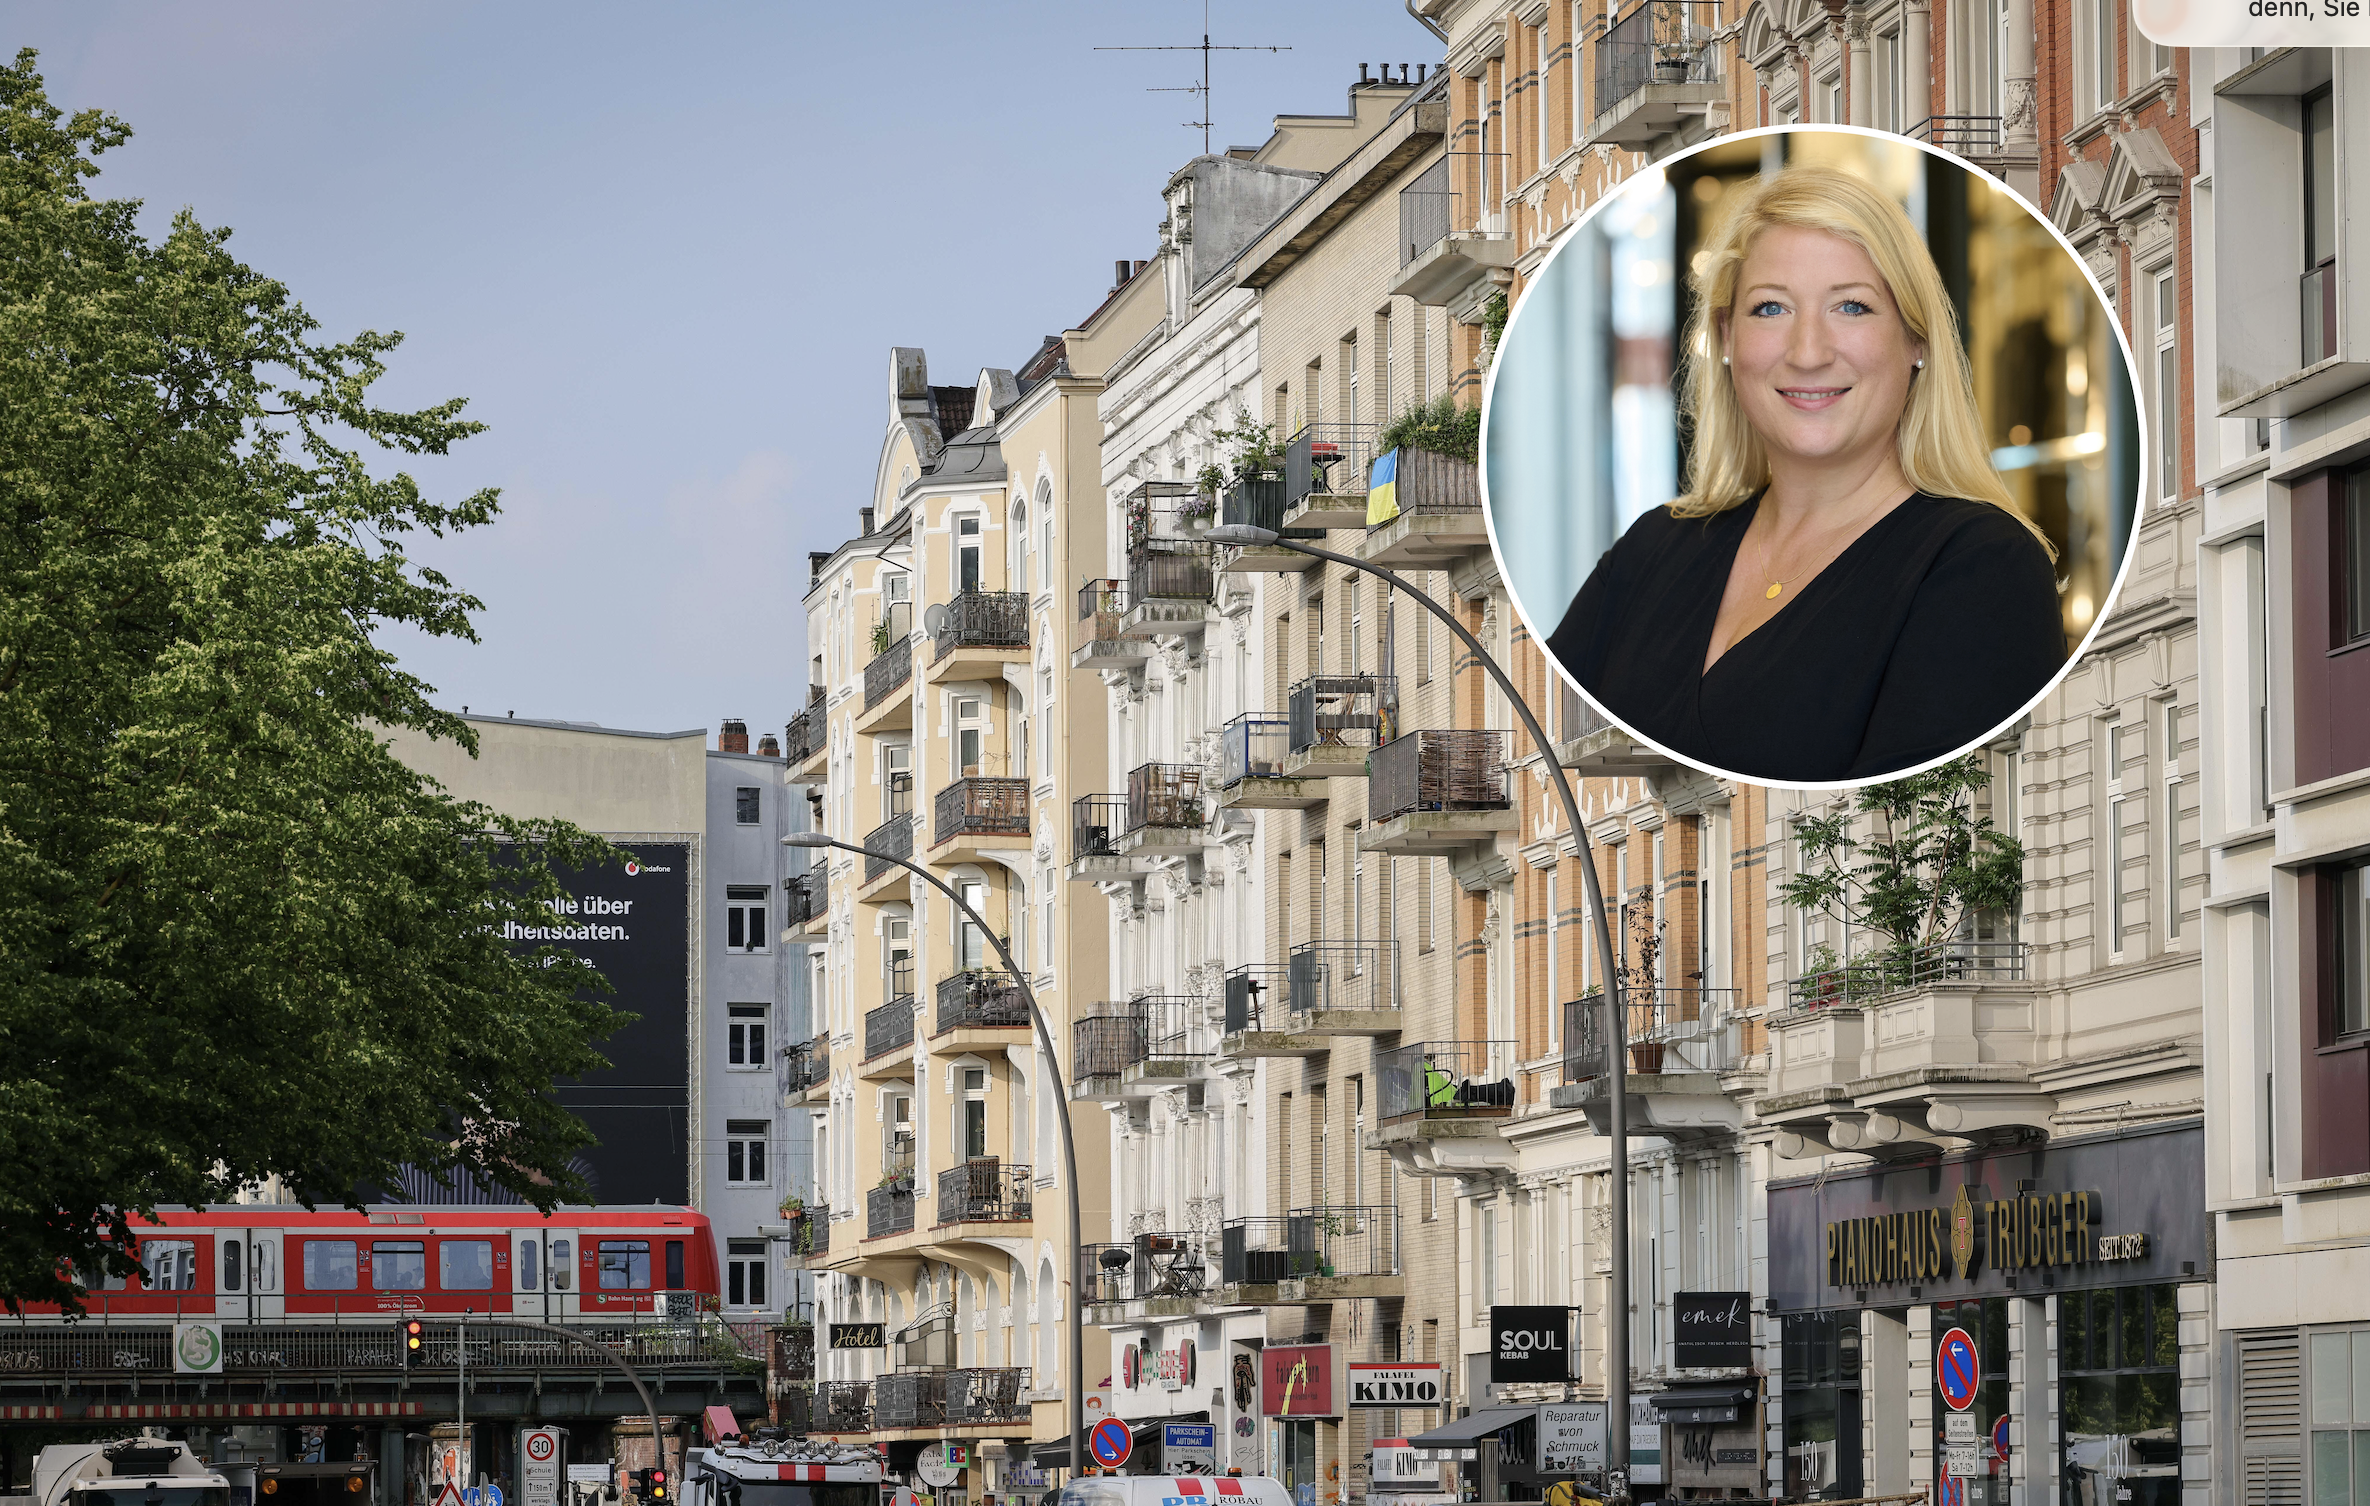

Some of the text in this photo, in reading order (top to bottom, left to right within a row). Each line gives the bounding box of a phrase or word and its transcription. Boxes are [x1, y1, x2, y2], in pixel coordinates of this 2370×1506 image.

[642, 865, 671, 873] odafone
[584, 896, 633, 915] über
[1827, 1206, 1941, 1286] PIANOHAUS
[1985, 1180, 2091, 1270] TRÜBGER
[2099, 1236, 2120, 1262] SEIT
[2120, 1232, 2144, 1260] 1872
[1681, 1298, 1746, 1329] emek
[834, 1326, 879, 1348] Hotel
[1500, 1330, 1563, 1351] SOUL
[1500, 1351, 1530, 1360] KEBAB
[1373, 1371, 1416, 1379] FALAFEL
[1353, 1381, 1437, 1401] KIMO
[1545, 1410, 1601, 1423] Reparatur
[1960, 1419, 1969, 1427] dem
[1169, 1427, 1209, 1437] PARKSCHEIN-
[1563, 1428, 1583, 1437] von
[1948, 1429, 1974, 1438] Seitenstreifen
[532, 1440, 549, 1454] 30
[1176, 1437, 1203, 1446] AUTOMAT
[1548, 1440, 1600, 1452] Schmuck
[922, 1450, 943, 1458] Fala
[1948, 1451, 1961, 1460] Mo-Fr
[2104, 1432, 2129, 1480] 150
[920, 1459, 943, 1468] Facto
[1396, 1452, 1418, 1476] KIMO
[1800, 1440, 1818, 1481] 150
[530, 1466, 552, 1474] Schule
[1951, 1462, 1974, 1472] Sa 7-12h
[2115, 1484, 2133, 1501] Jahre
[1219, 1494, 1264, 1506] RÖBAU
